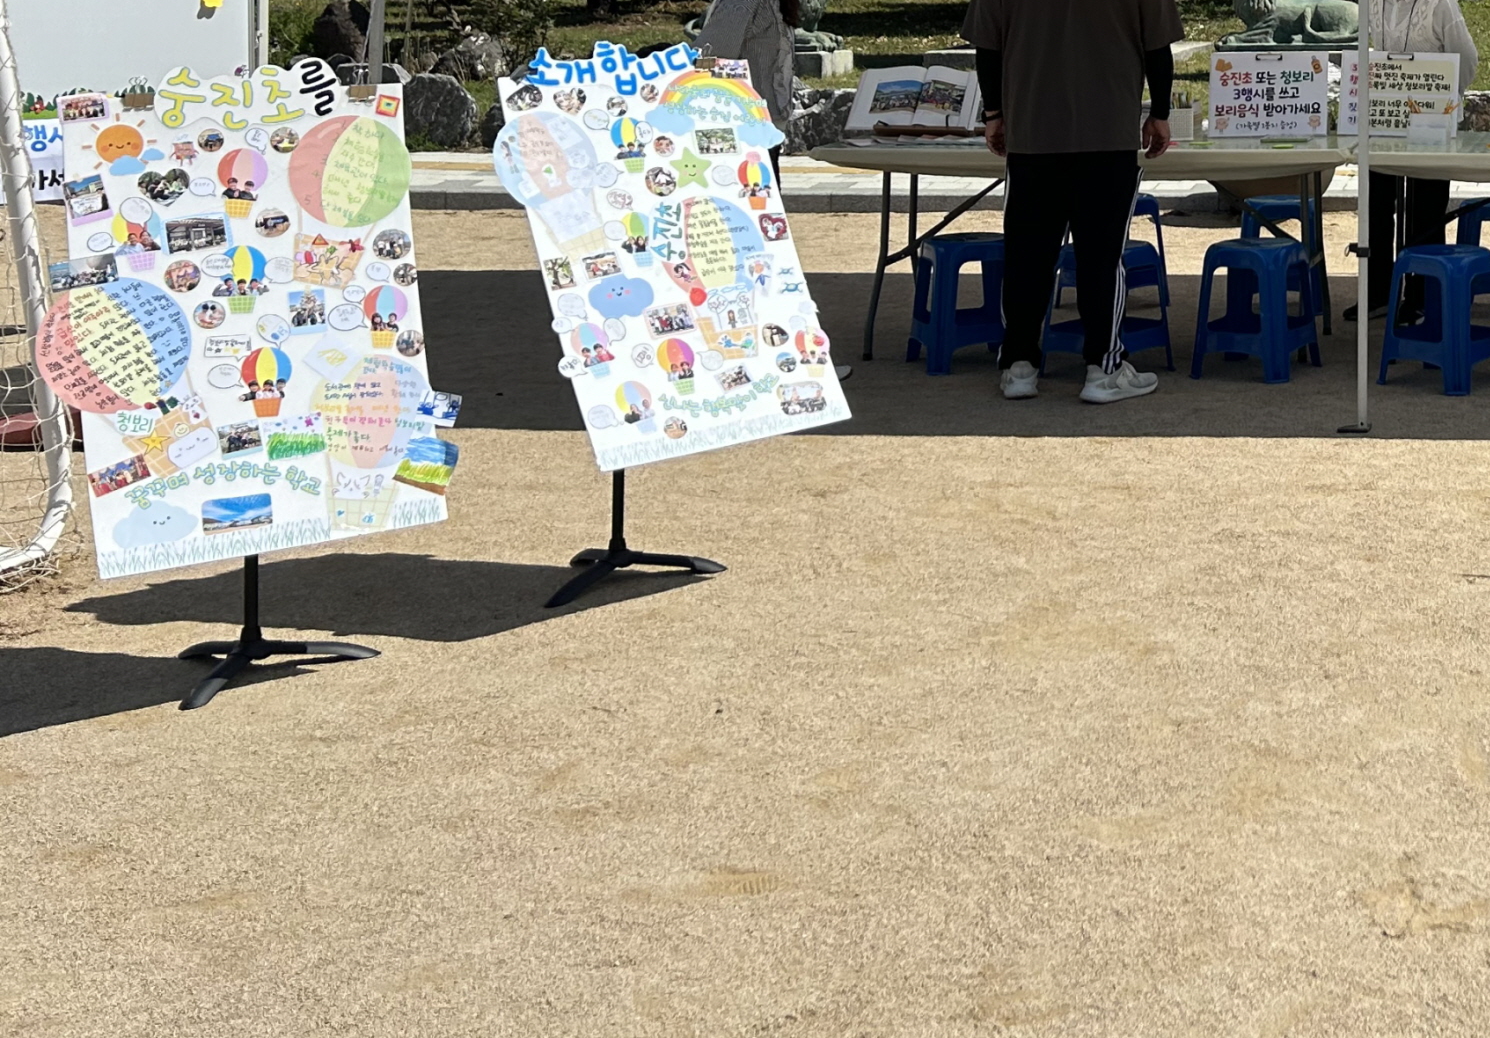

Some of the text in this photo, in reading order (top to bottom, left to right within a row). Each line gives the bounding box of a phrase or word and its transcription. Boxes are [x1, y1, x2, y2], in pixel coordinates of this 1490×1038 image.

[528, 40, 700, 96] 소개합니다
[1219, 70, 1314, 87] 숭진초 또는 청보리
[1233, 86, 1300, 102] 3행시를 쓰고
[1214, 101, 1321, 118] 보리음식 받아가세요
[1368, 99, 1386, 108] 보리
[116, 412, 156, 434] 청보리
[124, 460, 323, 510] 꿈꾸며 성장하는 학교
